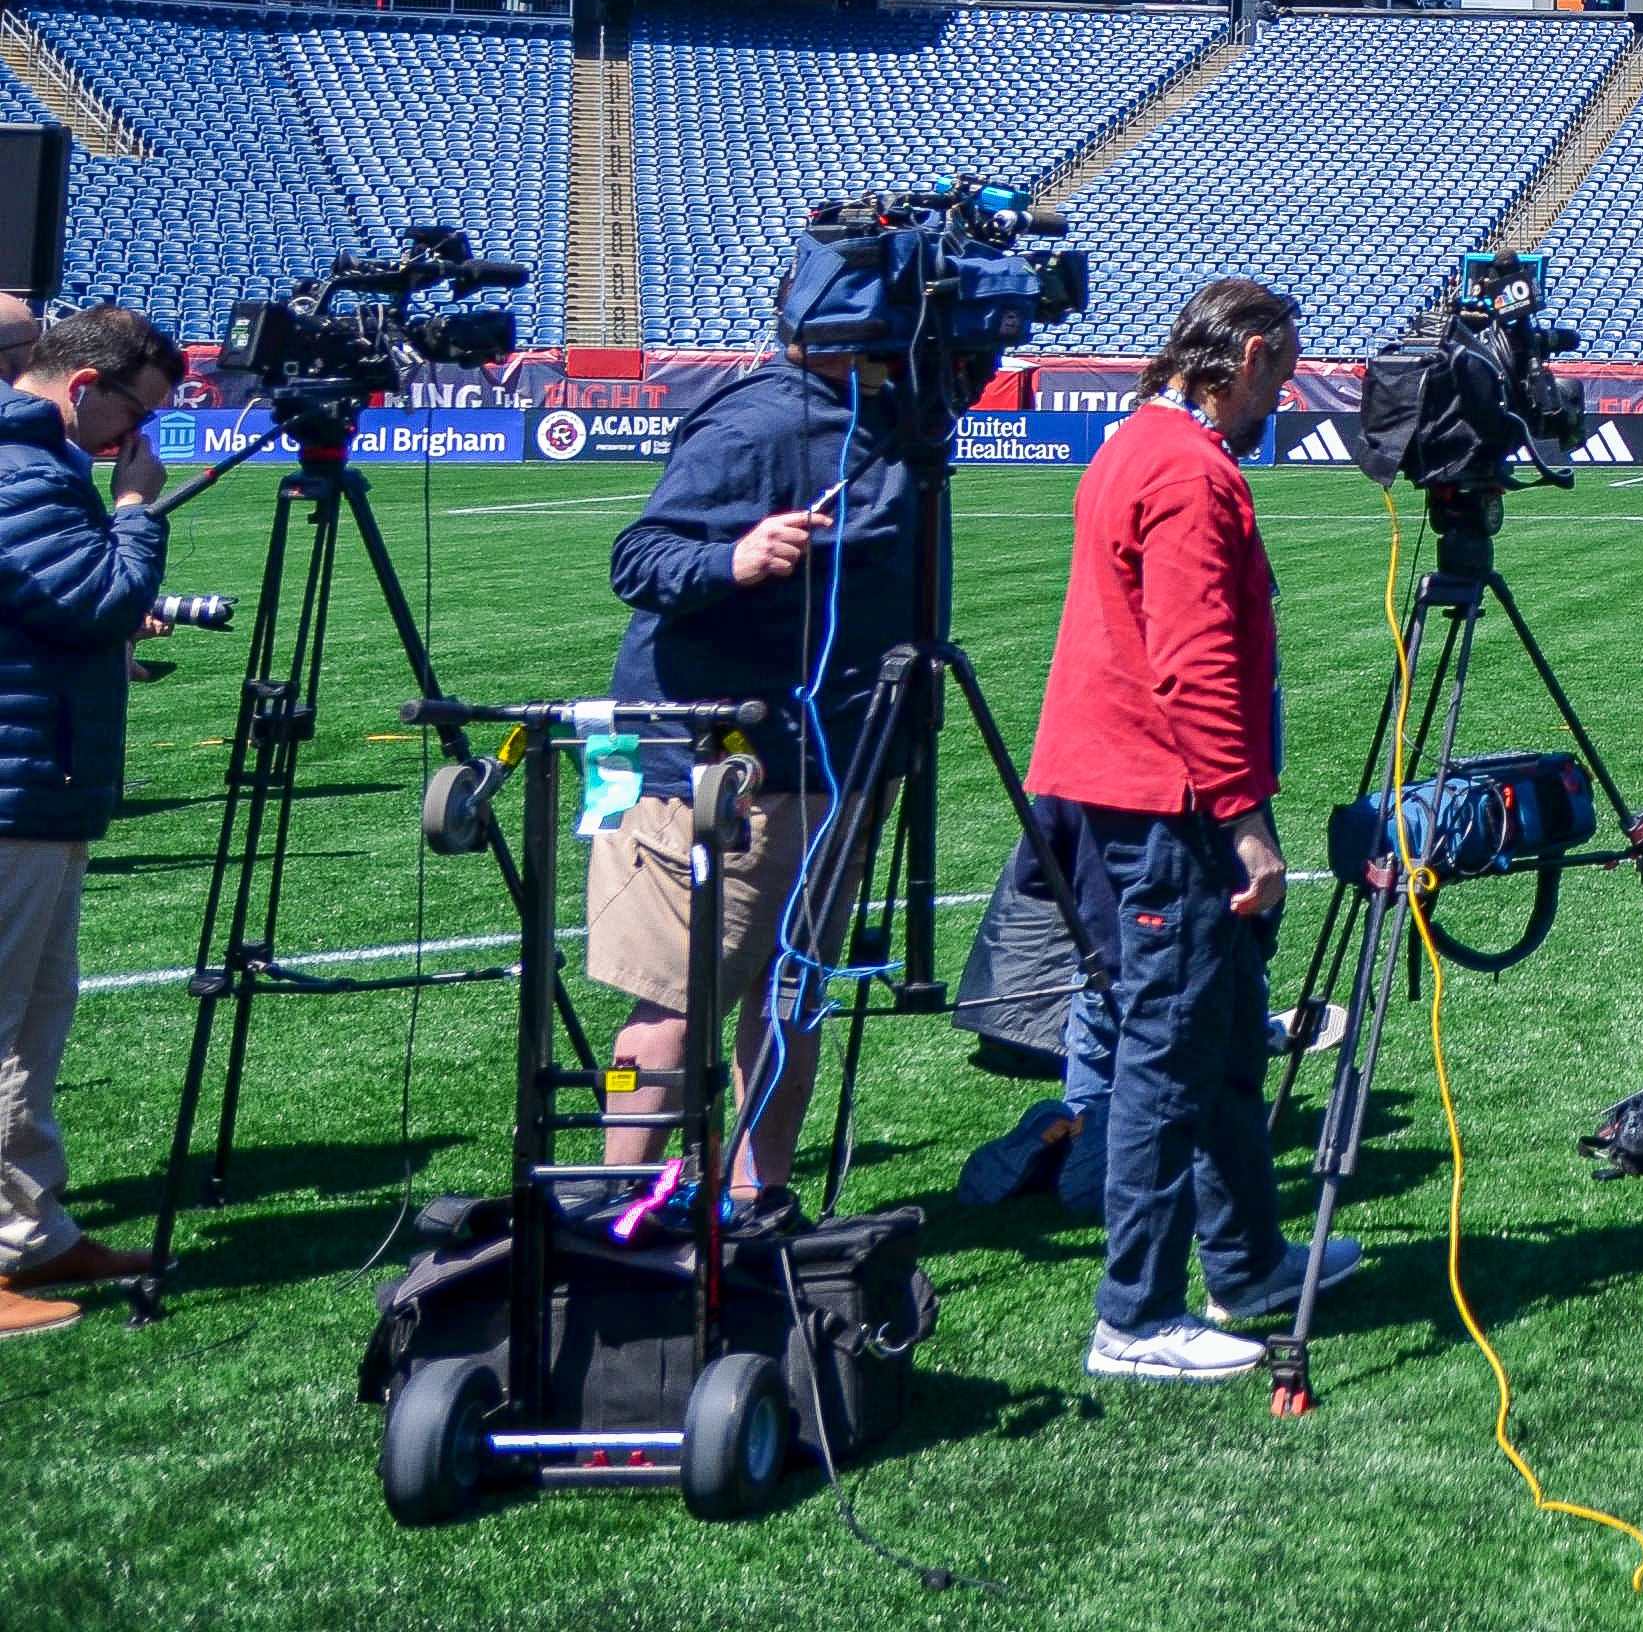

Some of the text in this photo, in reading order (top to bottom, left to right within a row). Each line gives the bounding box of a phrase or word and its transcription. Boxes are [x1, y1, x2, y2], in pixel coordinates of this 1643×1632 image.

[544, 383, 671, 409] FIGHT
[589, 415, 683, 436] ACADEM
[956, 416, 1028, 438] United
[281, 427, 386, 453] Gral
[393, 427, 506, 456] Brigham
[954, 438, 1070, 461] Healthcare
